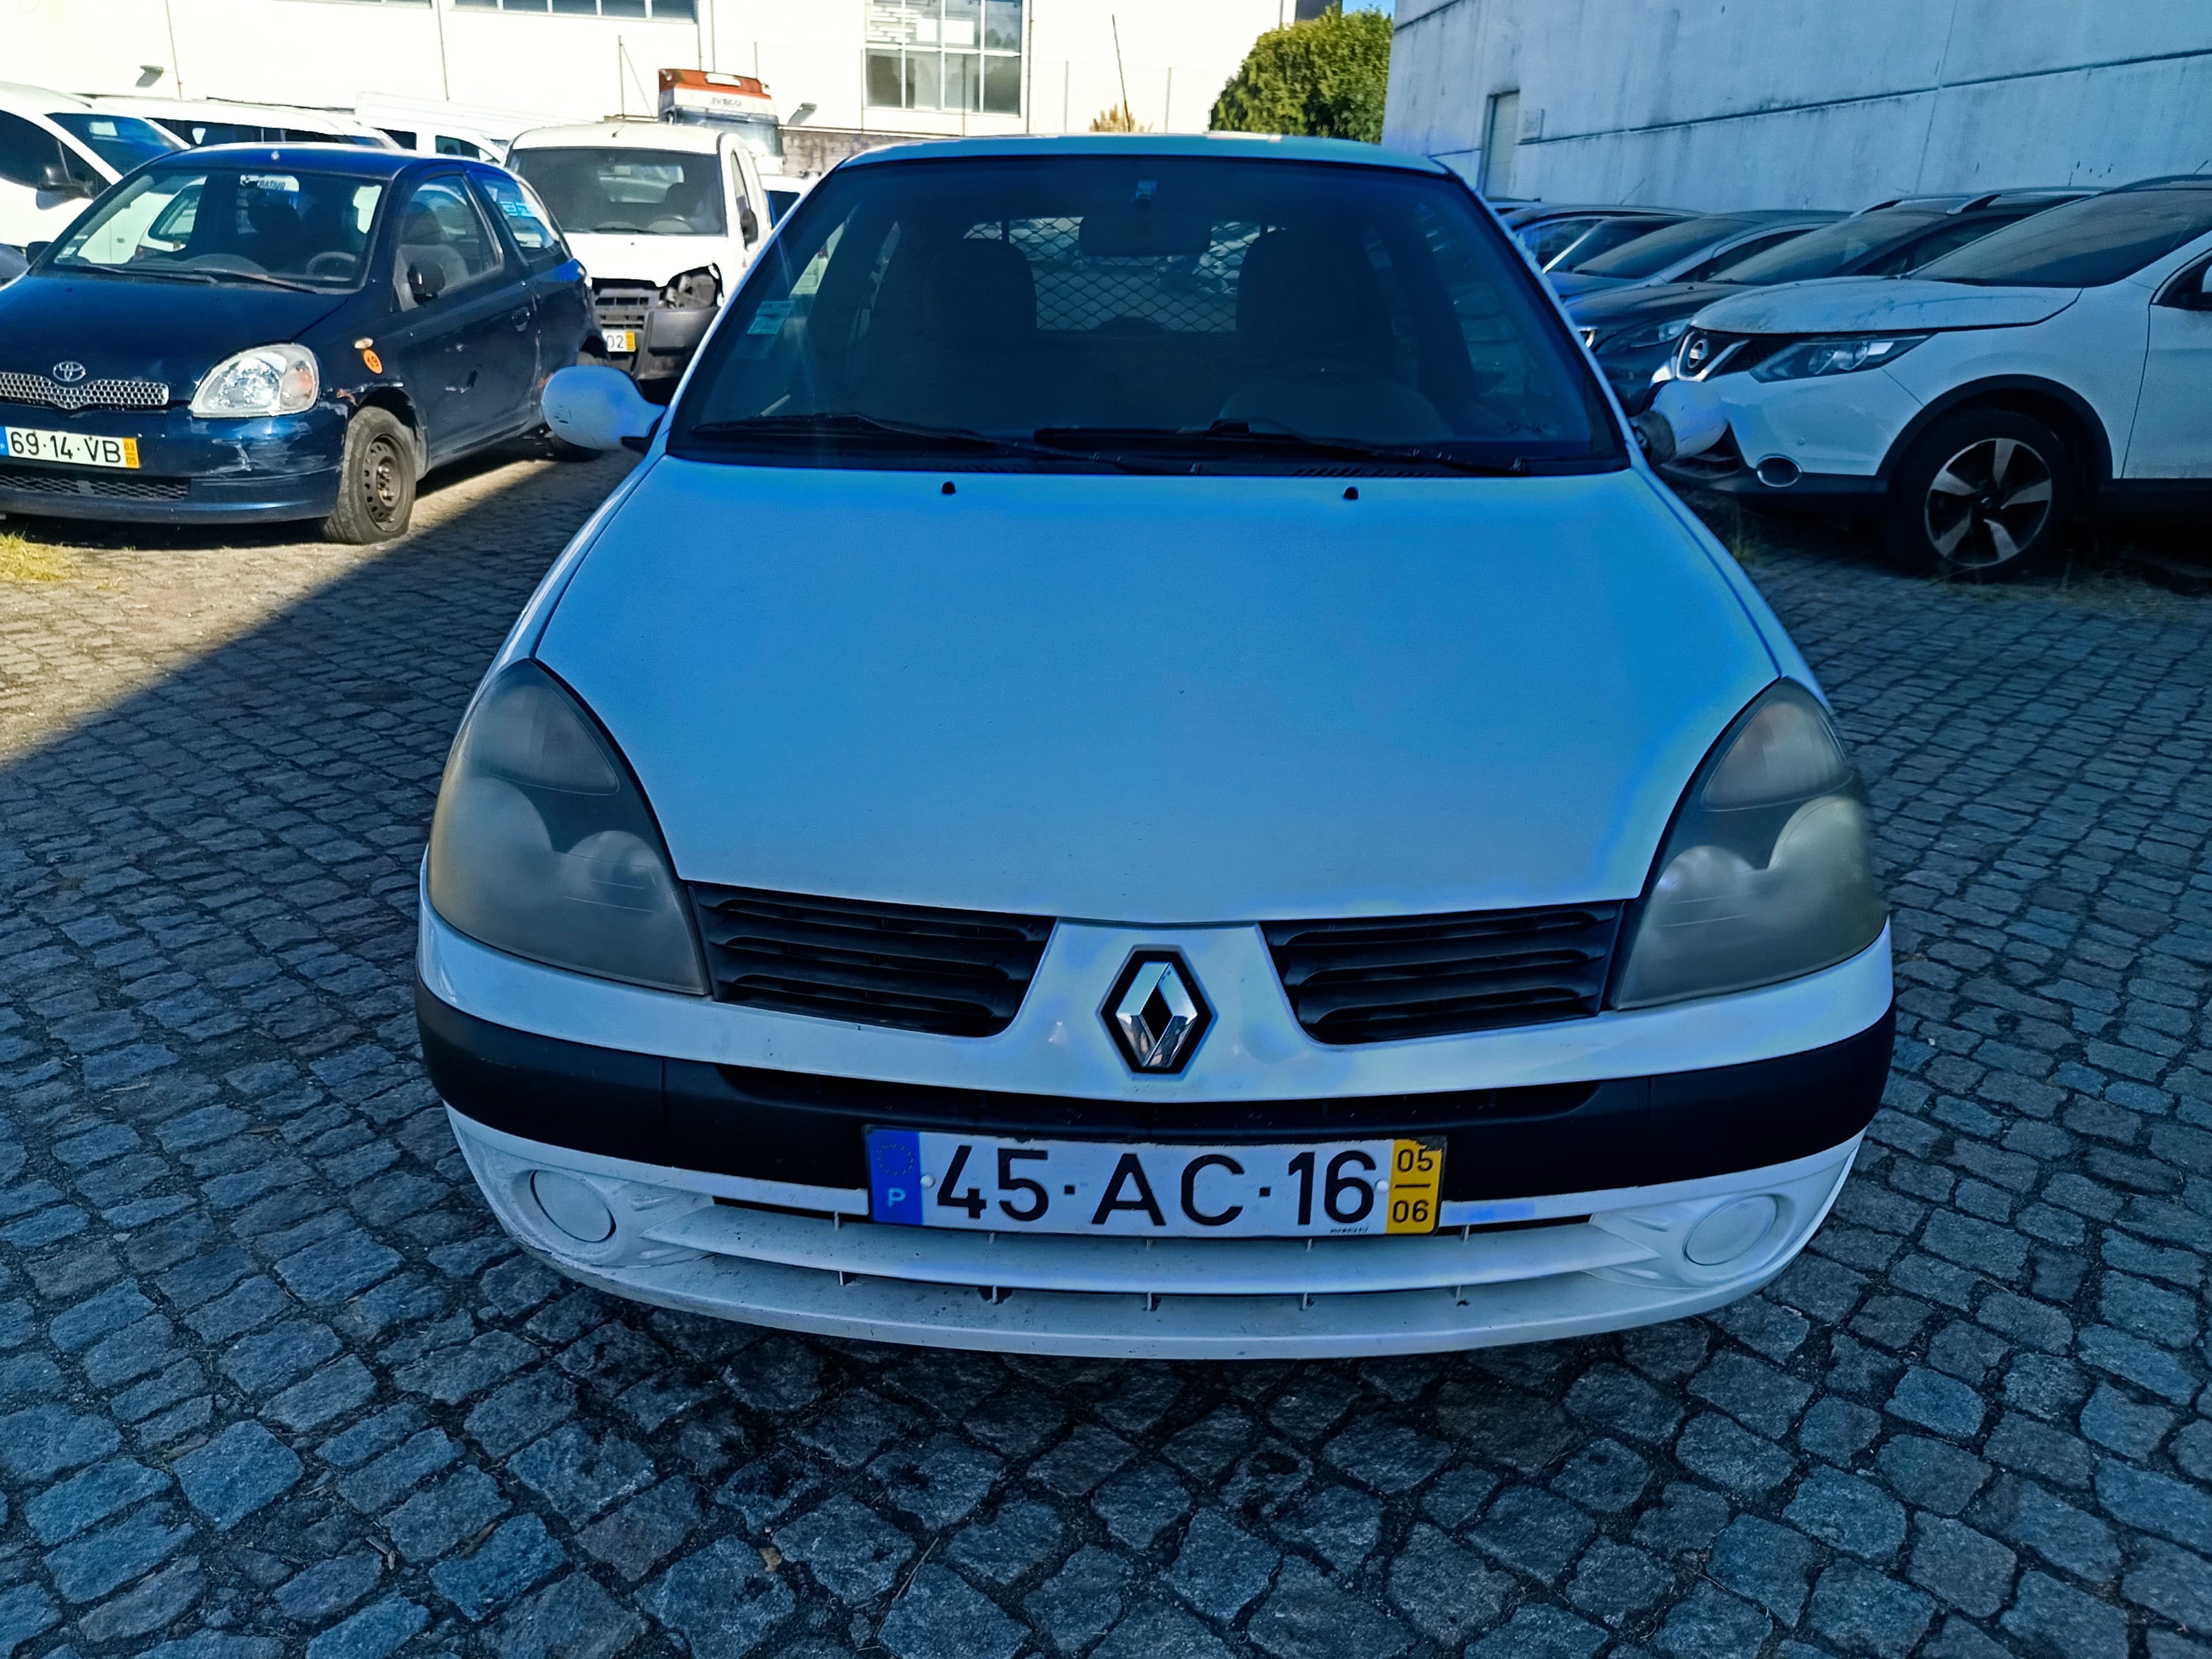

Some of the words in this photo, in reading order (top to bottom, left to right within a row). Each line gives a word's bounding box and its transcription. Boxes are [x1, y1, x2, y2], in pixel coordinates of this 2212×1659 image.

[711, 97, 743, 107] IVECO
[607, 335, 624, 349] 02
[367, 356, 379, 368] 19
[1397, 1149, 1433, 1172] 05
[888, 1187, 907, 1207] P
[1392, 1199, 1429, 1223] 06
